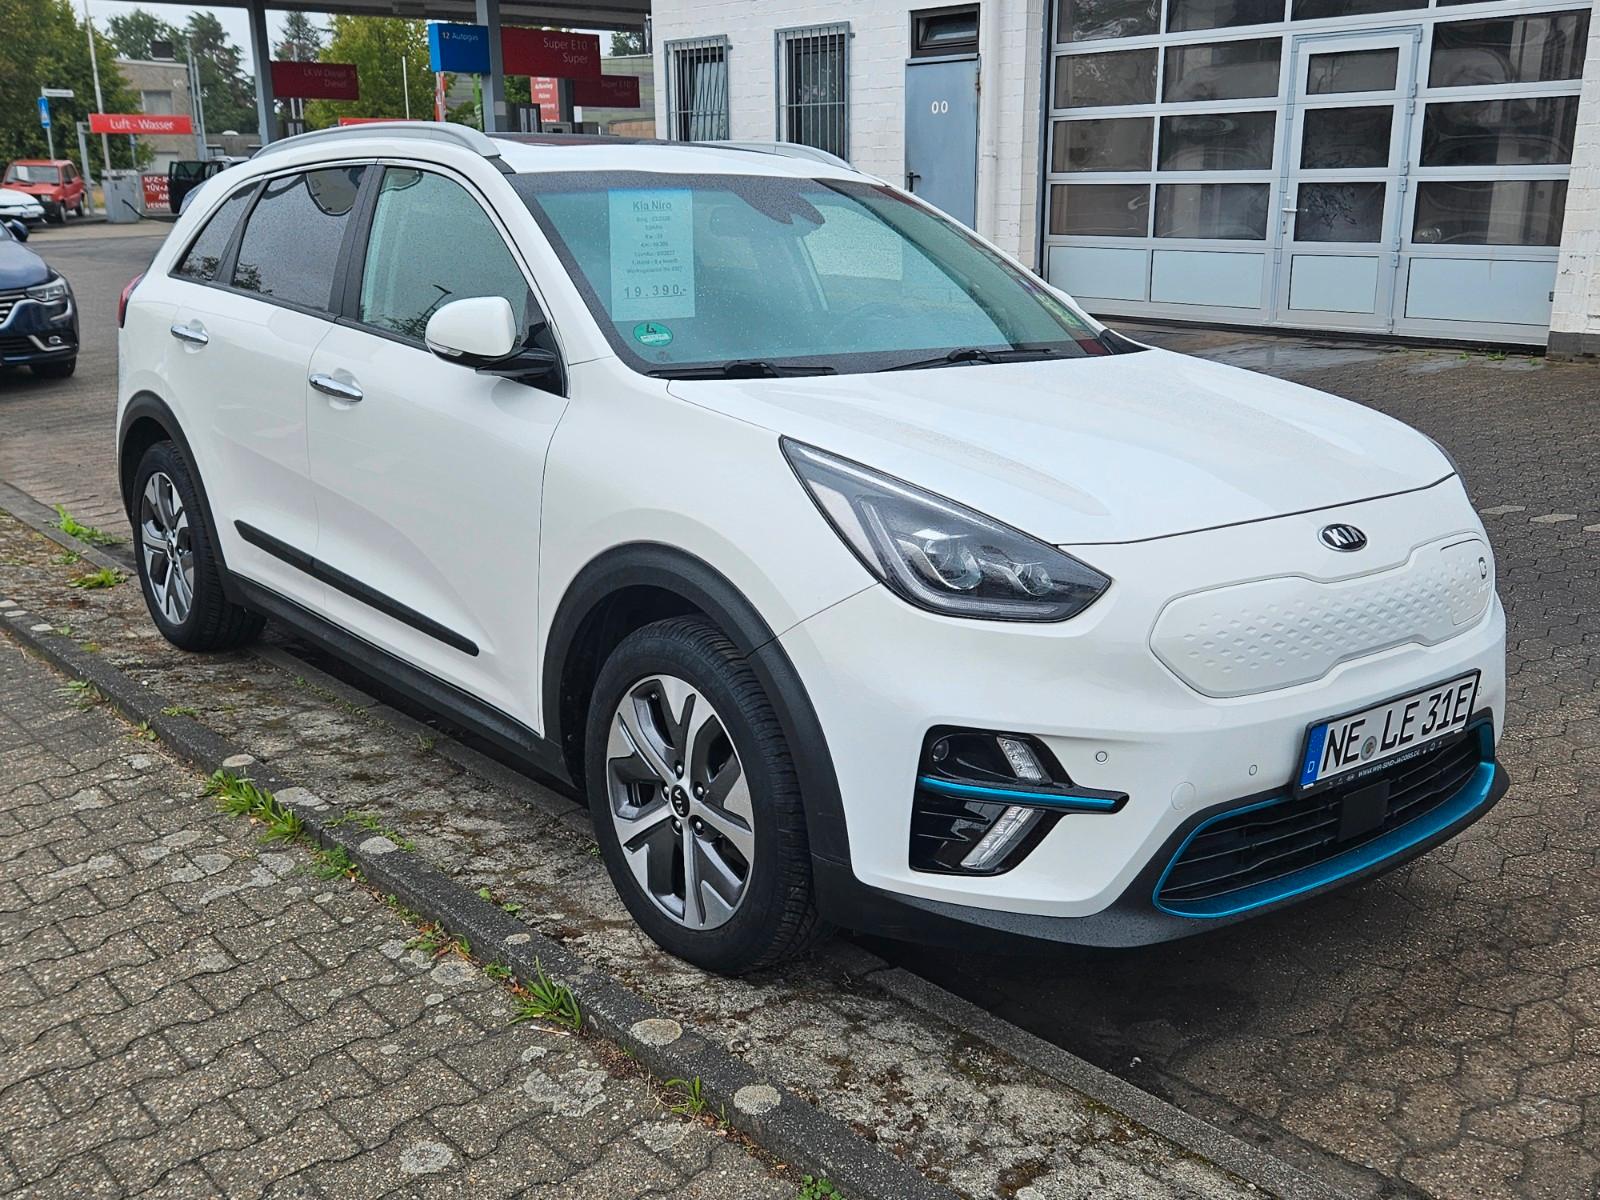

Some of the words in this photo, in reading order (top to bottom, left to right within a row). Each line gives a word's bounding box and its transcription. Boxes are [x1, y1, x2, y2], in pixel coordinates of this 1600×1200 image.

[442, 31, 450, 40] 12
[452, 32, 479, 42] Autogas
[543, 37, 569, 51] Super
[571, 39, 588, 50] E10
[562, 52, 588, 65] Super
[931, 100, 949, 114] 00
[109, 118, 130, 130] Luft
[138, 119, 174, 130] Wasser
[632, 200, 649, 210] Kia
[651, 199, 672, 210] Niro
[1322, 525, 1366, 547] KIA
[1306, 760, 1315, 774] D
[1321, 717, 1367, 773] NE
[1379, 699, 1421, 753] LE
[1421, 681, 1474, 737] 31E
